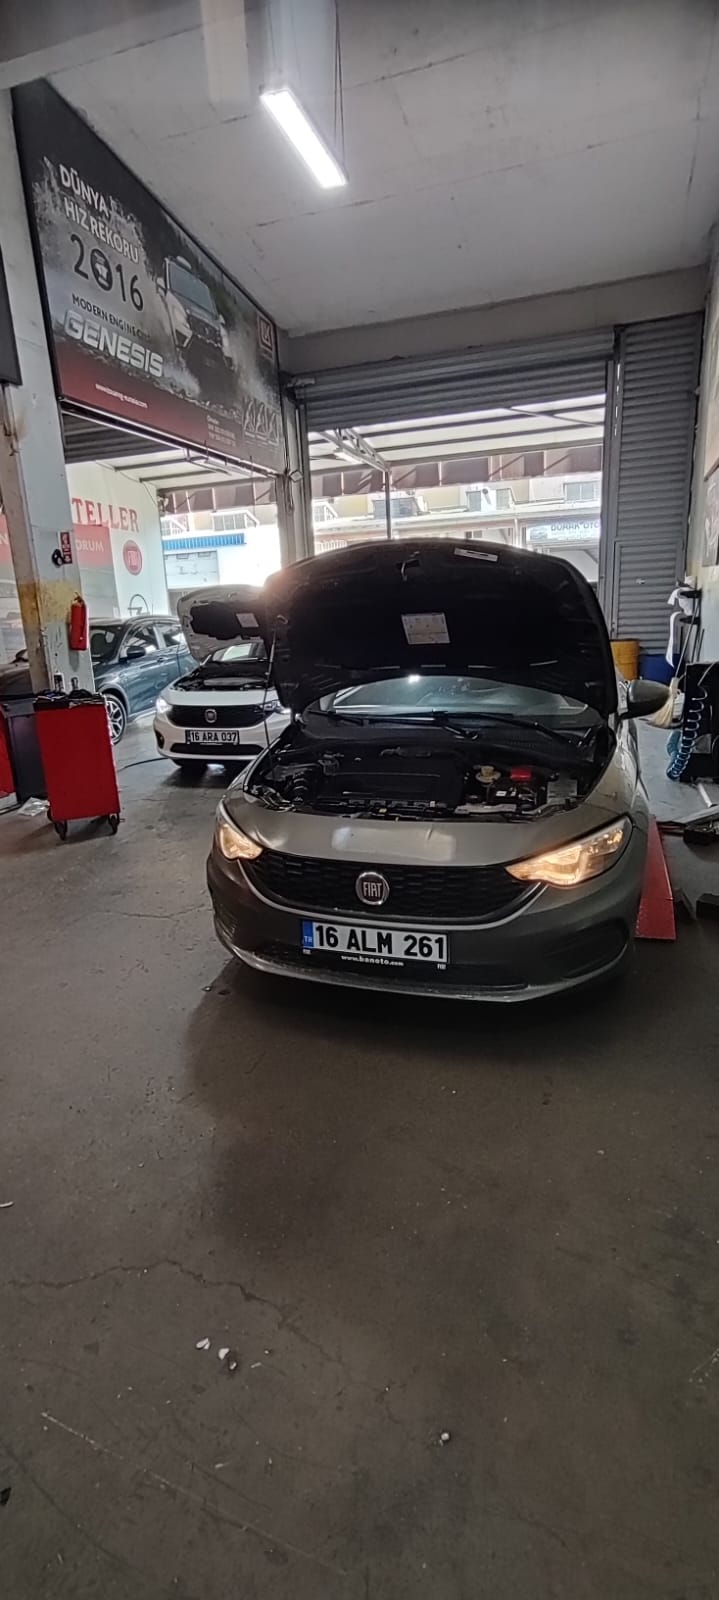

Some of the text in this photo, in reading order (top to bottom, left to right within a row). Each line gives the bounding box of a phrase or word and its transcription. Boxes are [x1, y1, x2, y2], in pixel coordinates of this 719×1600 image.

[59, 164, 109, 217] DÜNYA
[64, 197, 138, 262] HIZ REKORU
[71, 234, 143, 311] 2016
[72, 293, 107, 321] MODERN
[65, 310, 163, 377] GENESIS
[72, 498, 139, 533] TELLER
[191, 732, 237, 742] 16 ARA 037
[363, 882, 382, 898] FIAT
[315, 925, 339, 948] 16
[347, 929, 393, 954] ALM
[403, 934, 445, 960] 261
